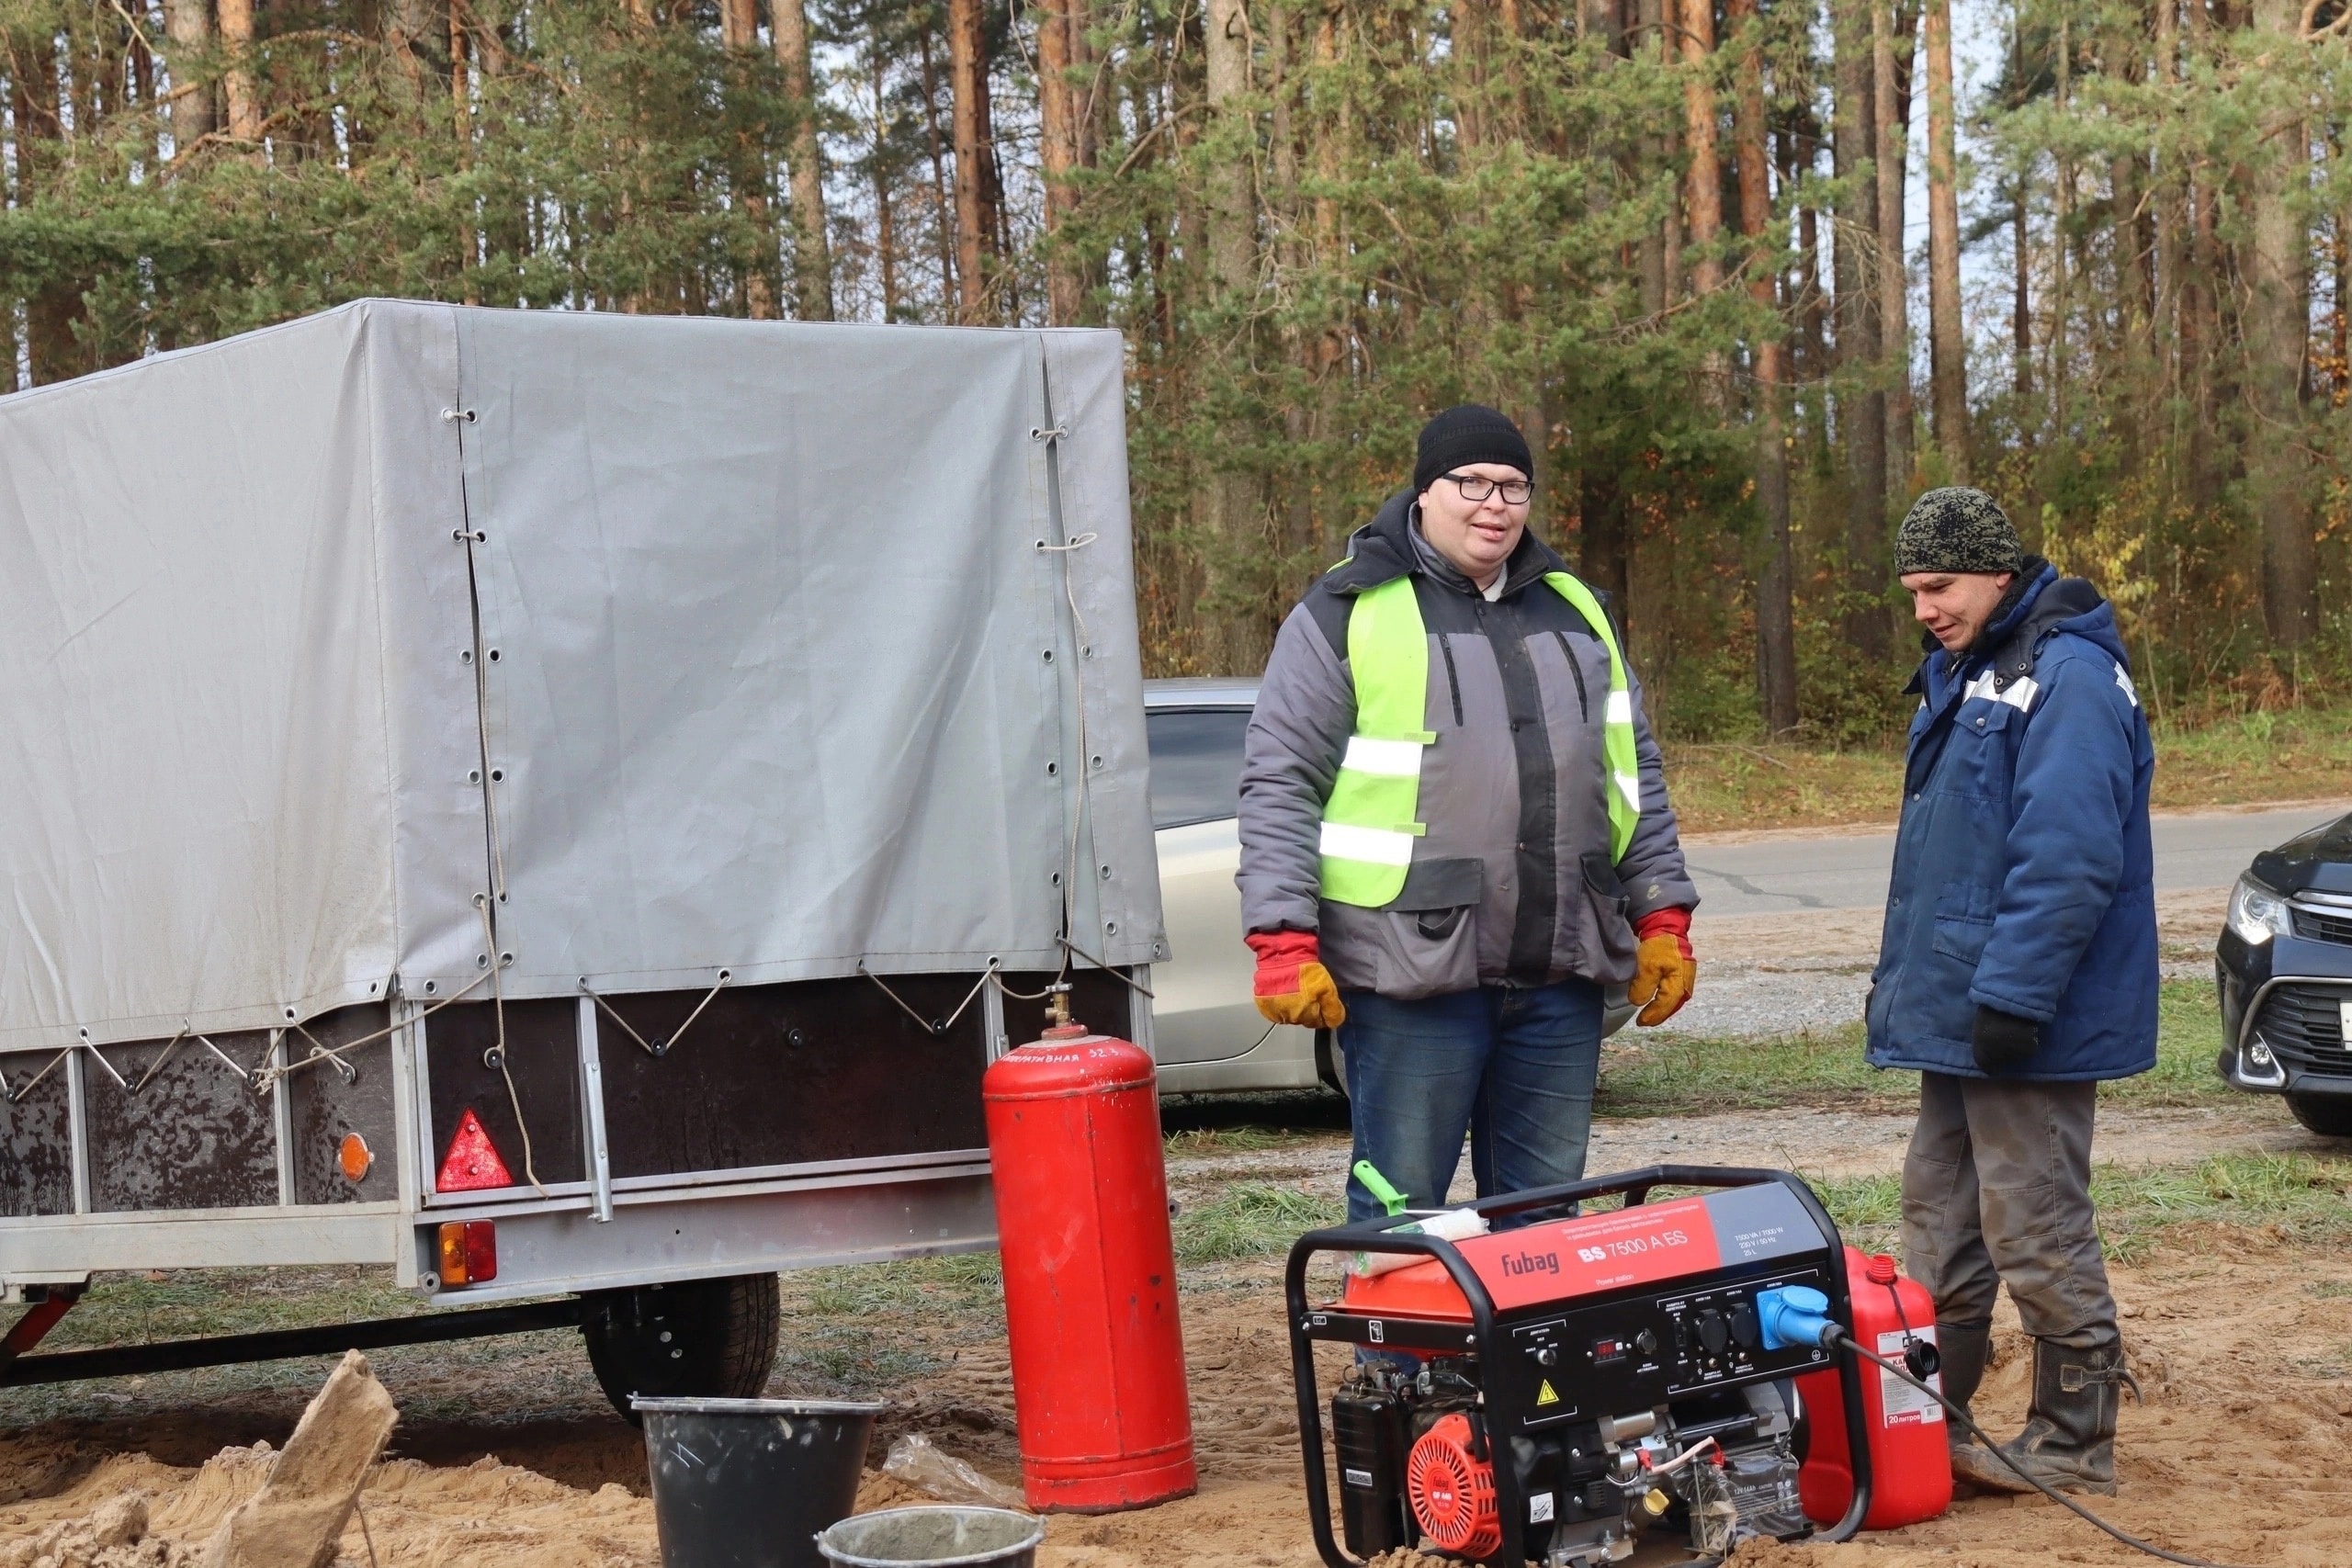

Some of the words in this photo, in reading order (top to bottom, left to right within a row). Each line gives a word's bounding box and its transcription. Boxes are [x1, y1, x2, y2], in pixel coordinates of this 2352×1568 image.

[1735, 1233, 1750, 1242] 7500
[1761, 1228, 1777, 1236] 7000
[1577, 1247, 1607, 1263] BS
[1607, 1238, 1647, 1258] 7500
[1651, 1235, 1666, 1249] A
[1738, 1241, 1751, 1249] 230
[1501, 1251, 1560, 1277] fubag
[1595, 1275, 1615, 1287] Power
[1615, 1273, 1635, 1283] station
[1888, 1415, 1898, 1424] 20
[1898, 1414, 1920, 1423] литров
